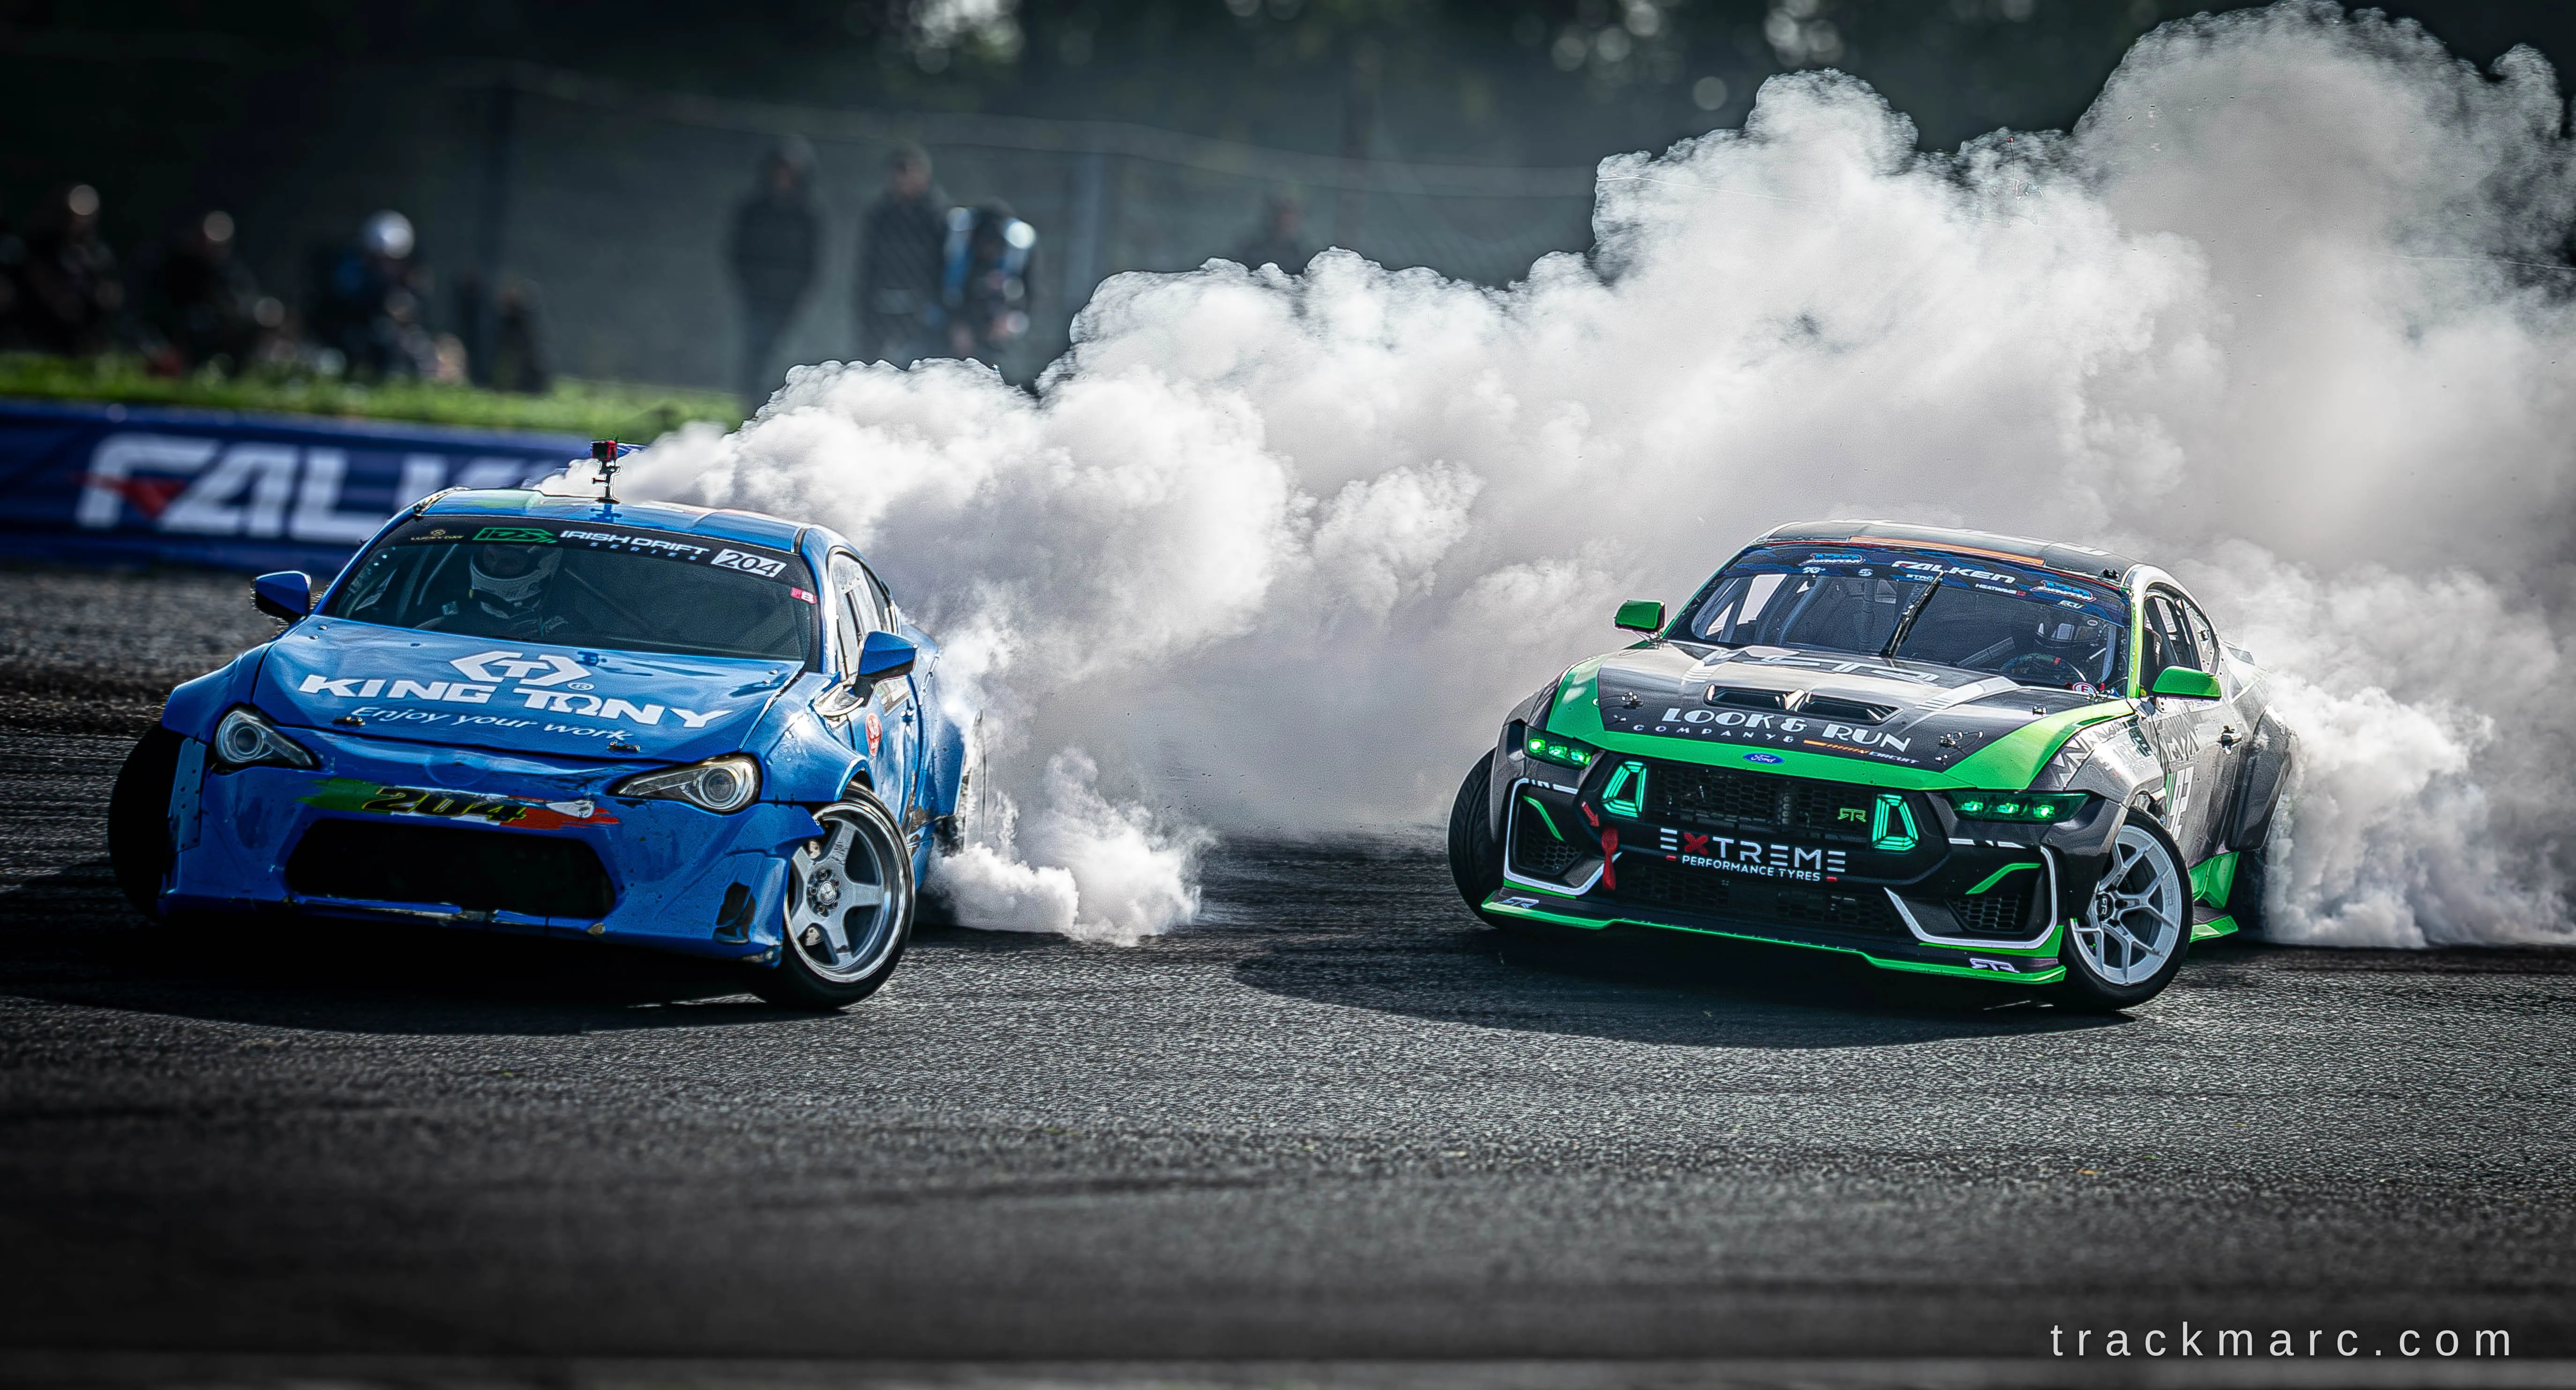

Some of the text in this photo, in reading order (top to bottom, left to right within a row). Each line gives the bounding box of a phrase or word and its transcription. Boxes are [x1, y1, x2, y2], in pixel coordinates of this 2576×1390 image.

[77, 433, 548, 542] FALK
[559, 530, 711, 555] IRISH DRIFT
[589, 542, 697, 561] SERIES
[723, 552, 780, 576] 204
[1891, 560, 2016, 584] FALKEN
[299, 674, 734, 728] KING TONY
[351, 706, 634, 740] Enjoy your work
[1632, 724, 1776, 740] COMPANY
[1662, 707, 1775, 729] LOOK
[1822, 723, 1912, 753] RUN
[361, 786, 527, 822] 204
[1660, 827, 1847, 873] EXTREME
[1682, 855, 1821, 882] PERFORMANCE TYRES
